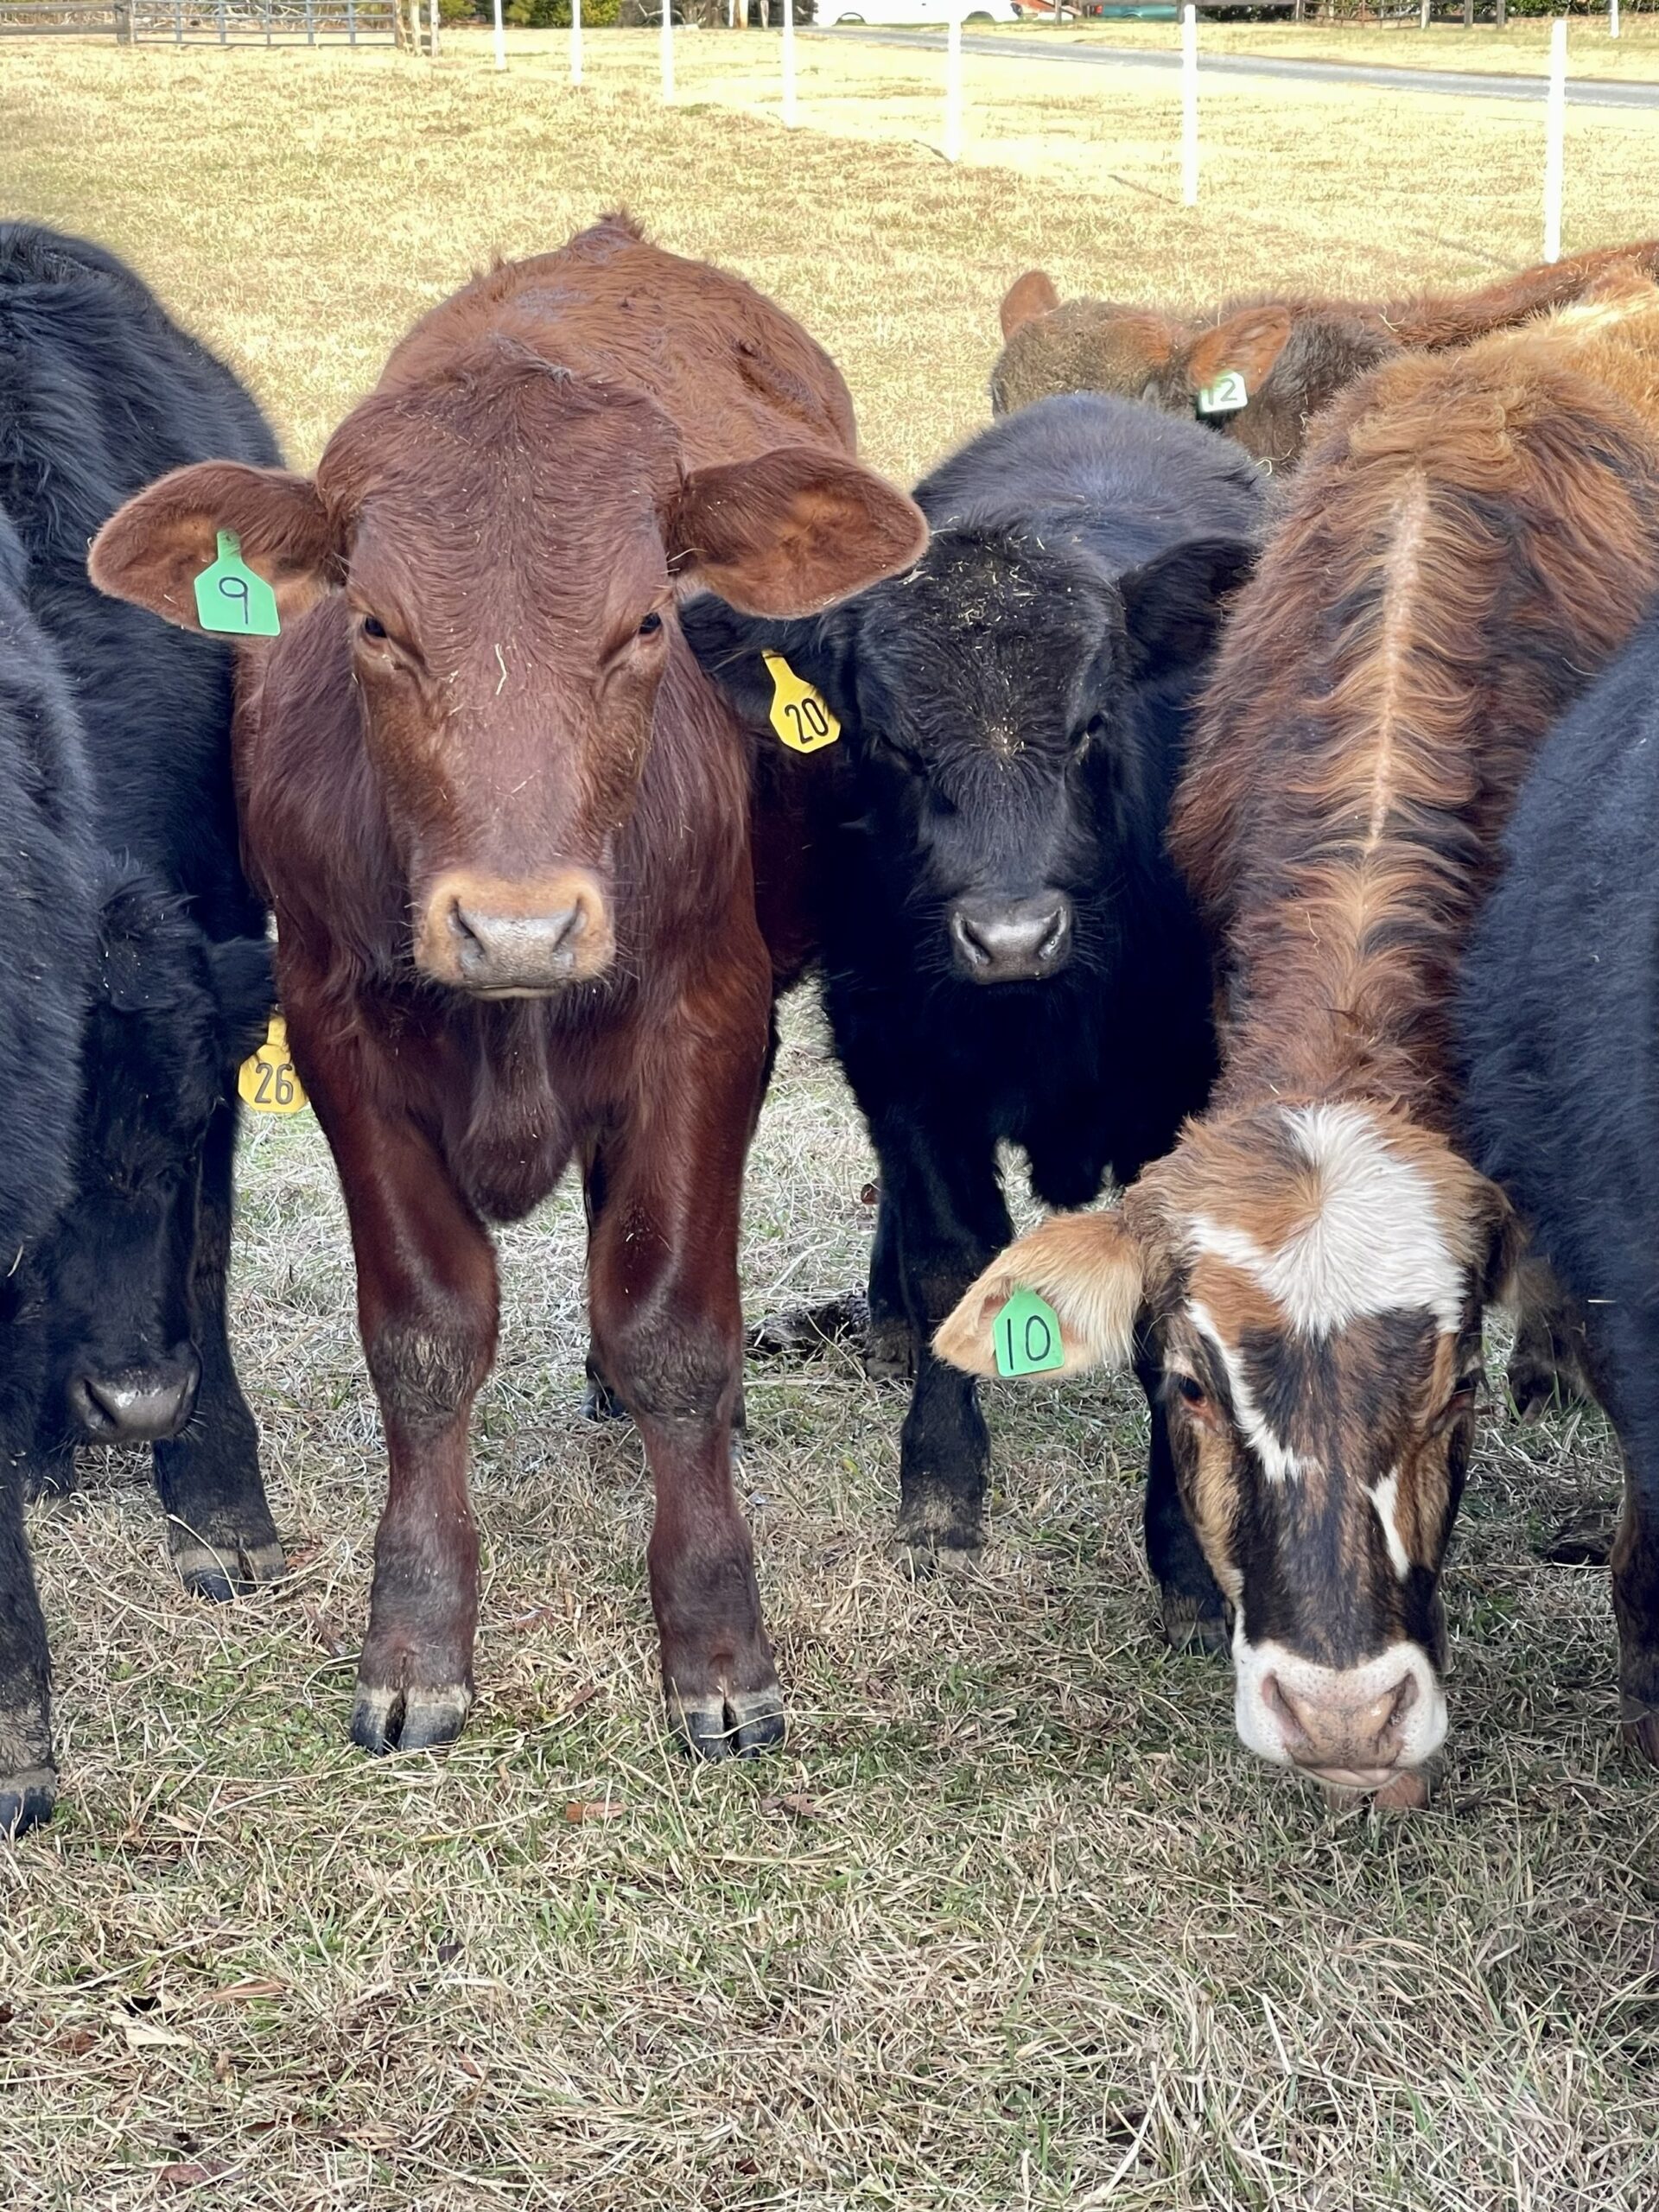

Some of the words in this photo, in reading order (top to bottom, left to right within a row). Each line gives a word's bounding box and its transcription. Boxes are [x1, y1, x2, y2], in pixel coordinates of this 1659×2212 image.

[1206, 378, 1238, 405] 12
[219, 576, 249, 625] 9
[784, 697, 830, 744] 20
[254, 1062, 295, 1104] 26
[1007, 1314, 1052, 1370] 10
